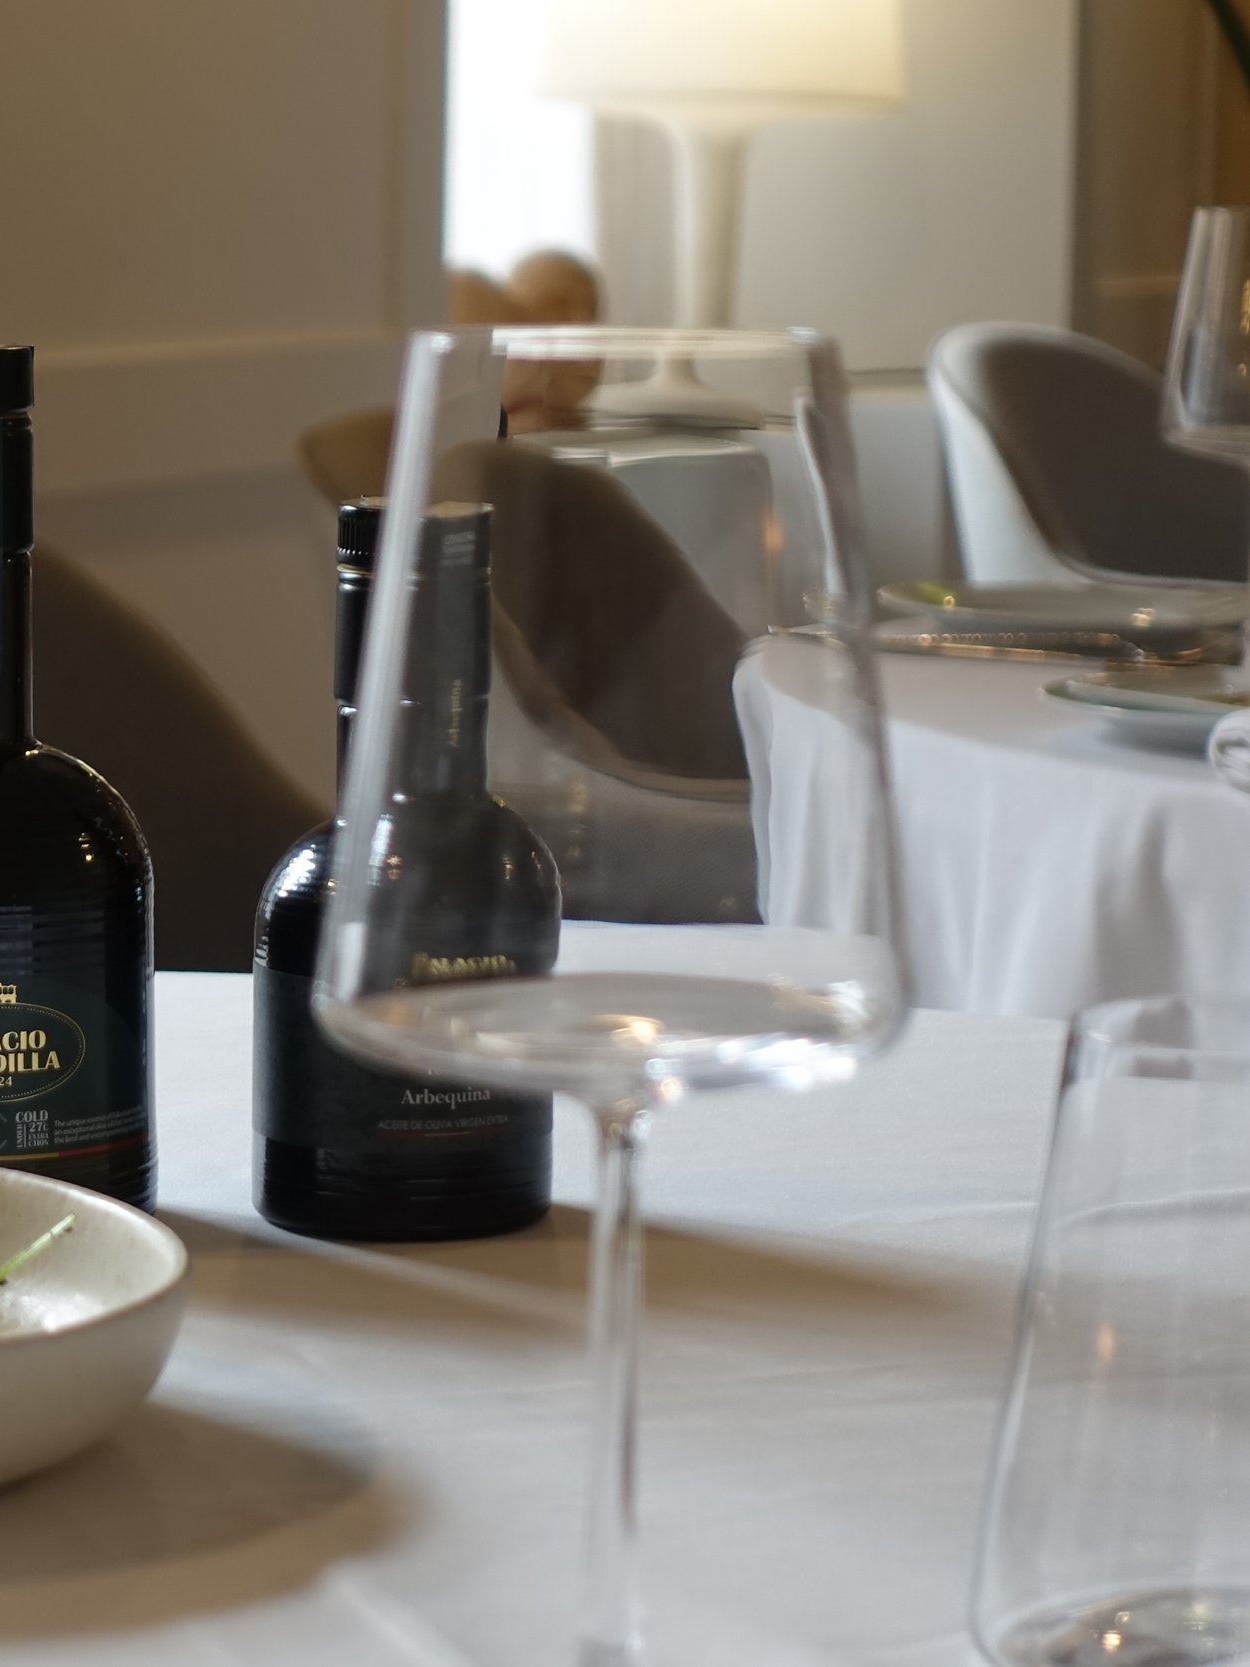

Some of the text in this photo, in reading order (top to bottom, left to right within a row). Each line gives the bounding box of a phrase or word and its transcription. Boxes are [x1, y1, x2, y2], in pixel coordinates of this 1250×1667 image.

[400, 1087, 490, 1110] Arbequina
[15, 1110, 49, 1123] COLD
[410, 1120, 423, 1130] DE
[424, 1119, 452, 1130] OLIVA
